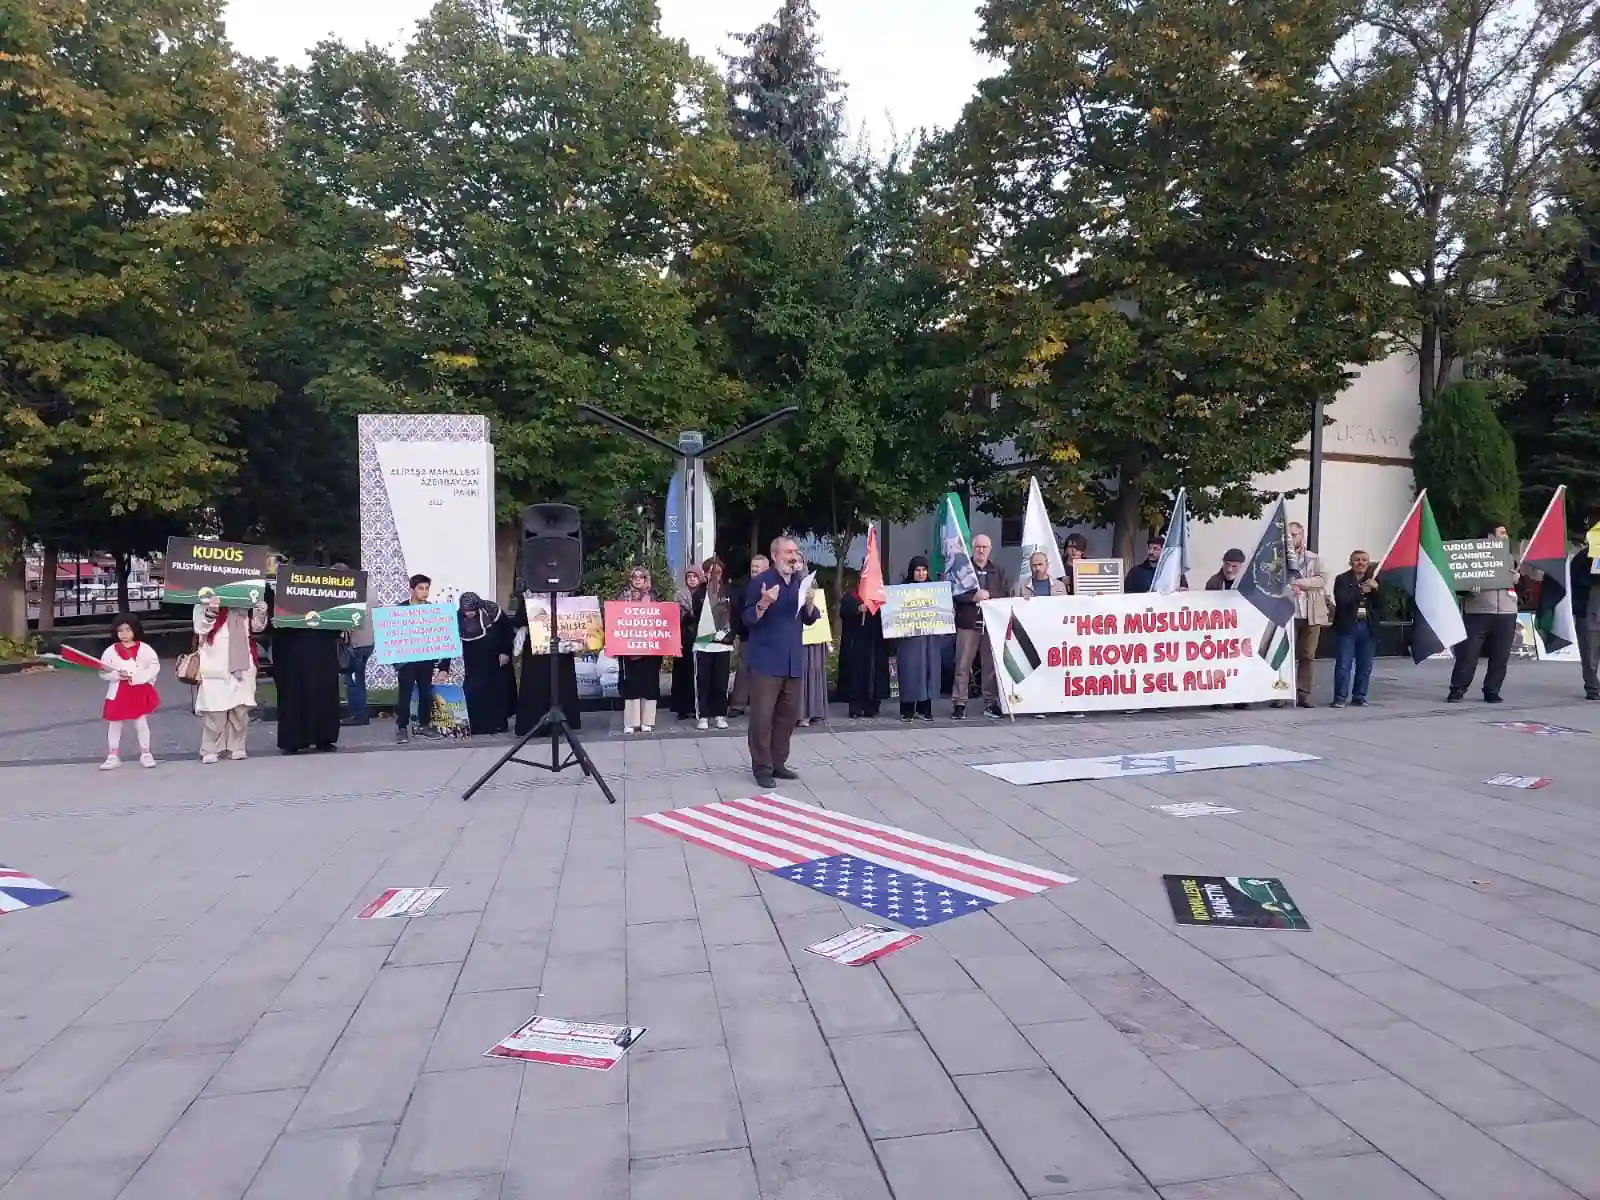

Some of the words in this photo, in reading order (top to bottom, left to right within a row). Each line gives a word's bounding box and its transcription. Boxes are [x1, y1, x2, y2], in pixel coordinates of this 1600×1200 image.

[420, 478, 479, 487] AZERBAYCAN
[193, 545, 244, 562] KUDÜS
[290, 572, 321, 585] İSLAM
[286, 586, 357, 600] KURULMALIDIR
[1123, 606, 1238, 634] MÜSLÜMAN
[1047, 641, 1083, 668] BİR
[1089, 643, 1148, 666] KOVA
[1153, 642, 1180, 664] SU
[1185, 634, 1253, 662] DÖKSE
[1064, 669, 1137, 697] İSRAİLİ
[1142, 671, 1179, 694] SEL
